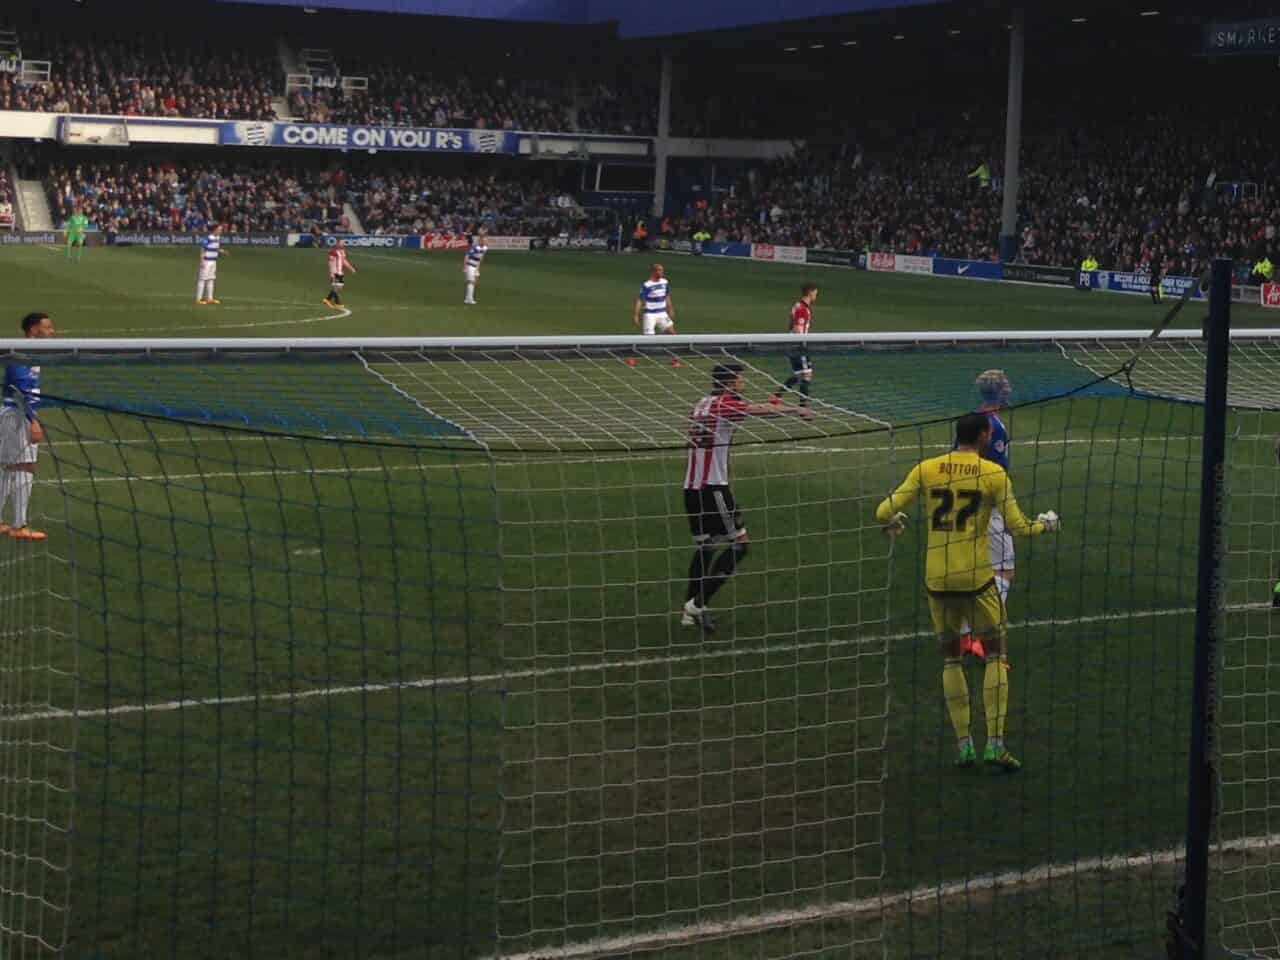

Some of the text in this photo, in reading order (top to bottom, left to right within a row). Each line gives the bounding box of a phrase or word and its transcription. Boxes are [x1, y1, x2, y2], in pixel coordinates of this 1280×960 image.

[283, 126, 348, 146] COME
[352, 129, 385, 148] ON
[386, 130, 433, 149] YOU
[930, 489, 982, 531] 27
